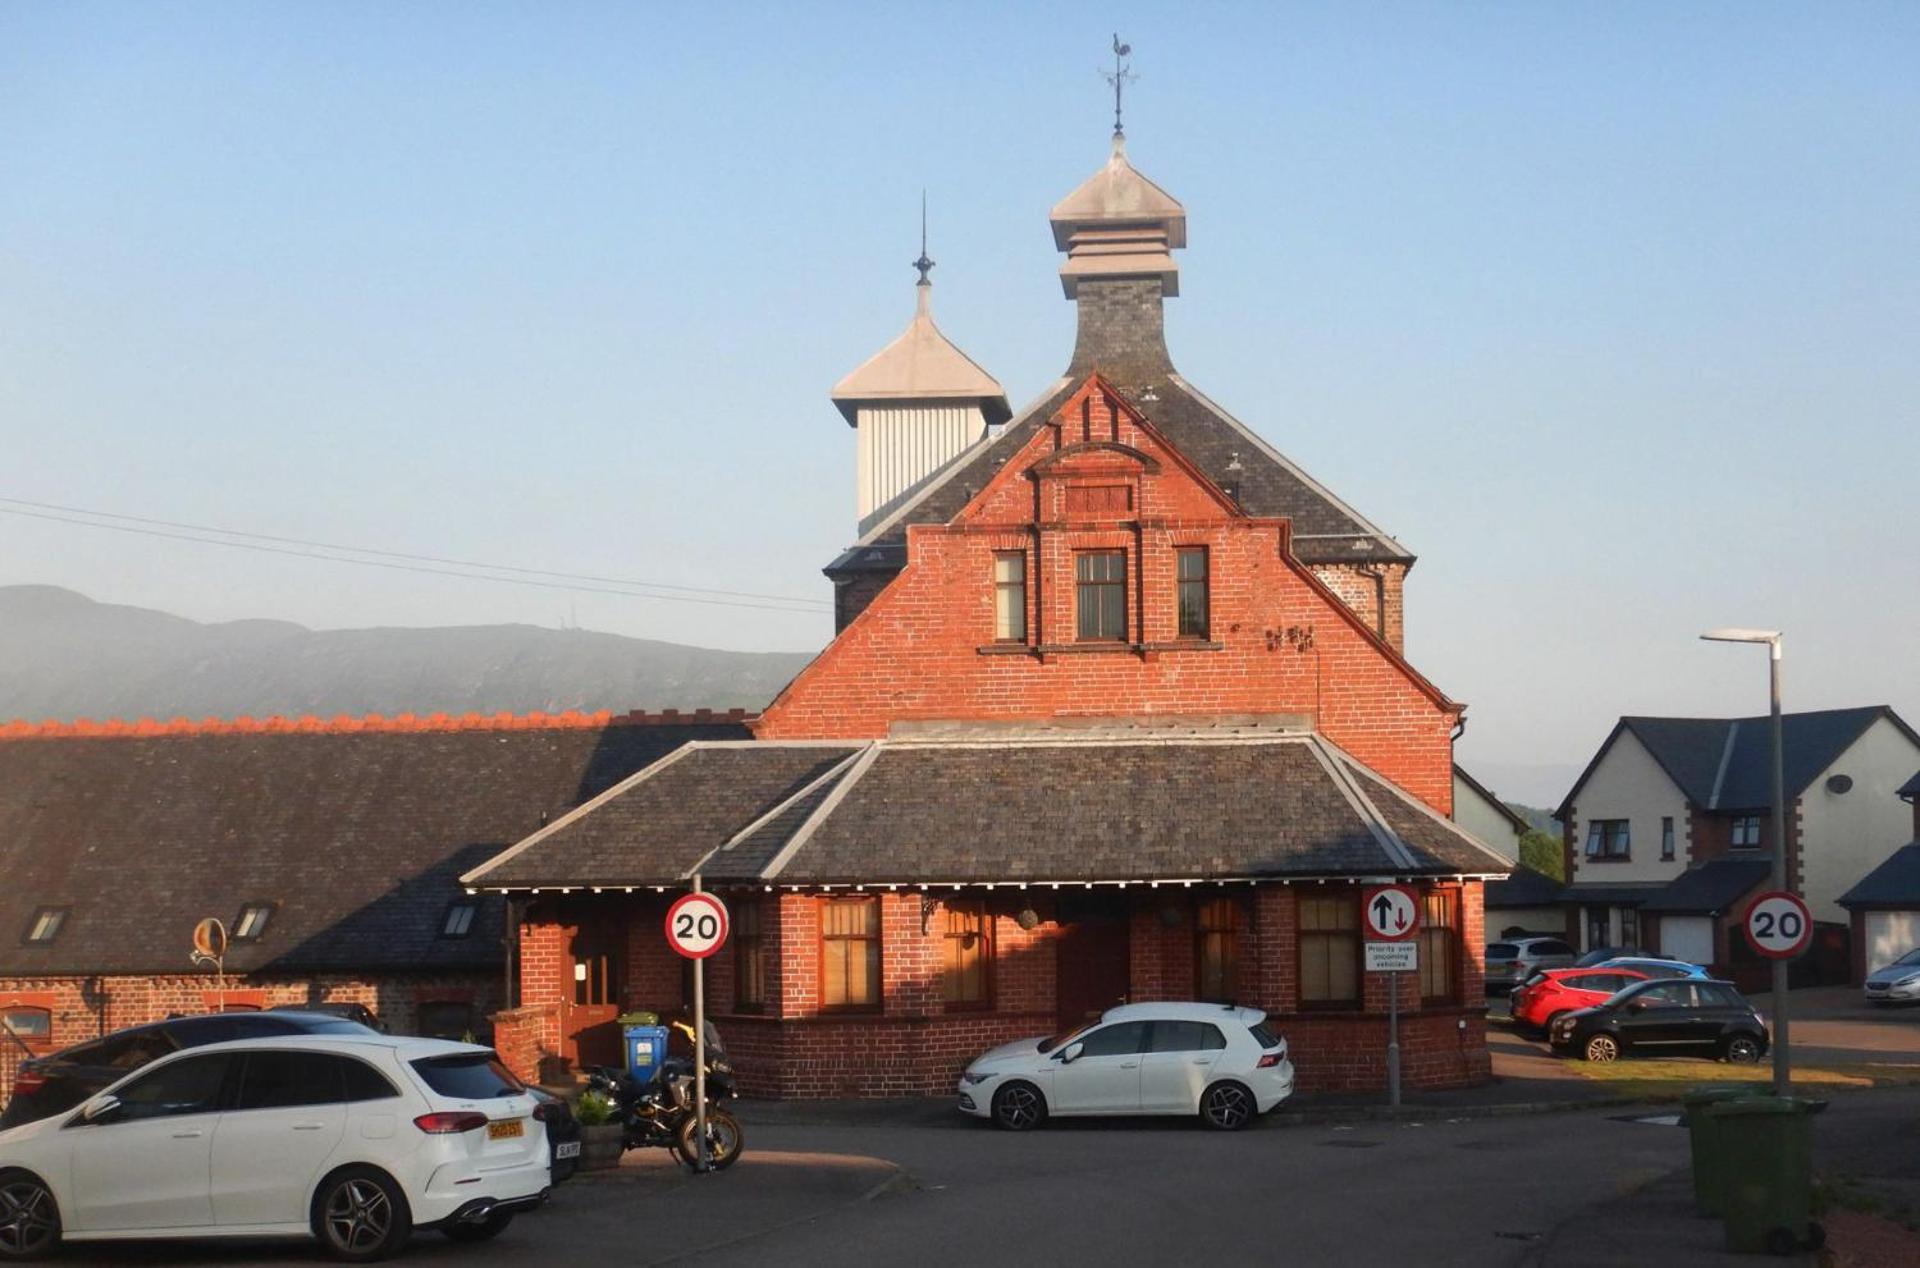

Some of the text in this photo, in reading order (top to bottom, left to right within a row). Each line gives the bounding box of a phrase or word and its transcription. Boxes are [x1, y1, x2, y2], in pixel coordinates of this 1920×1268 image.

[677, 914, 717, 939] 20
[1754, 911, 1801, 938] 20
[1368, 945, 1395, 953] Priority
